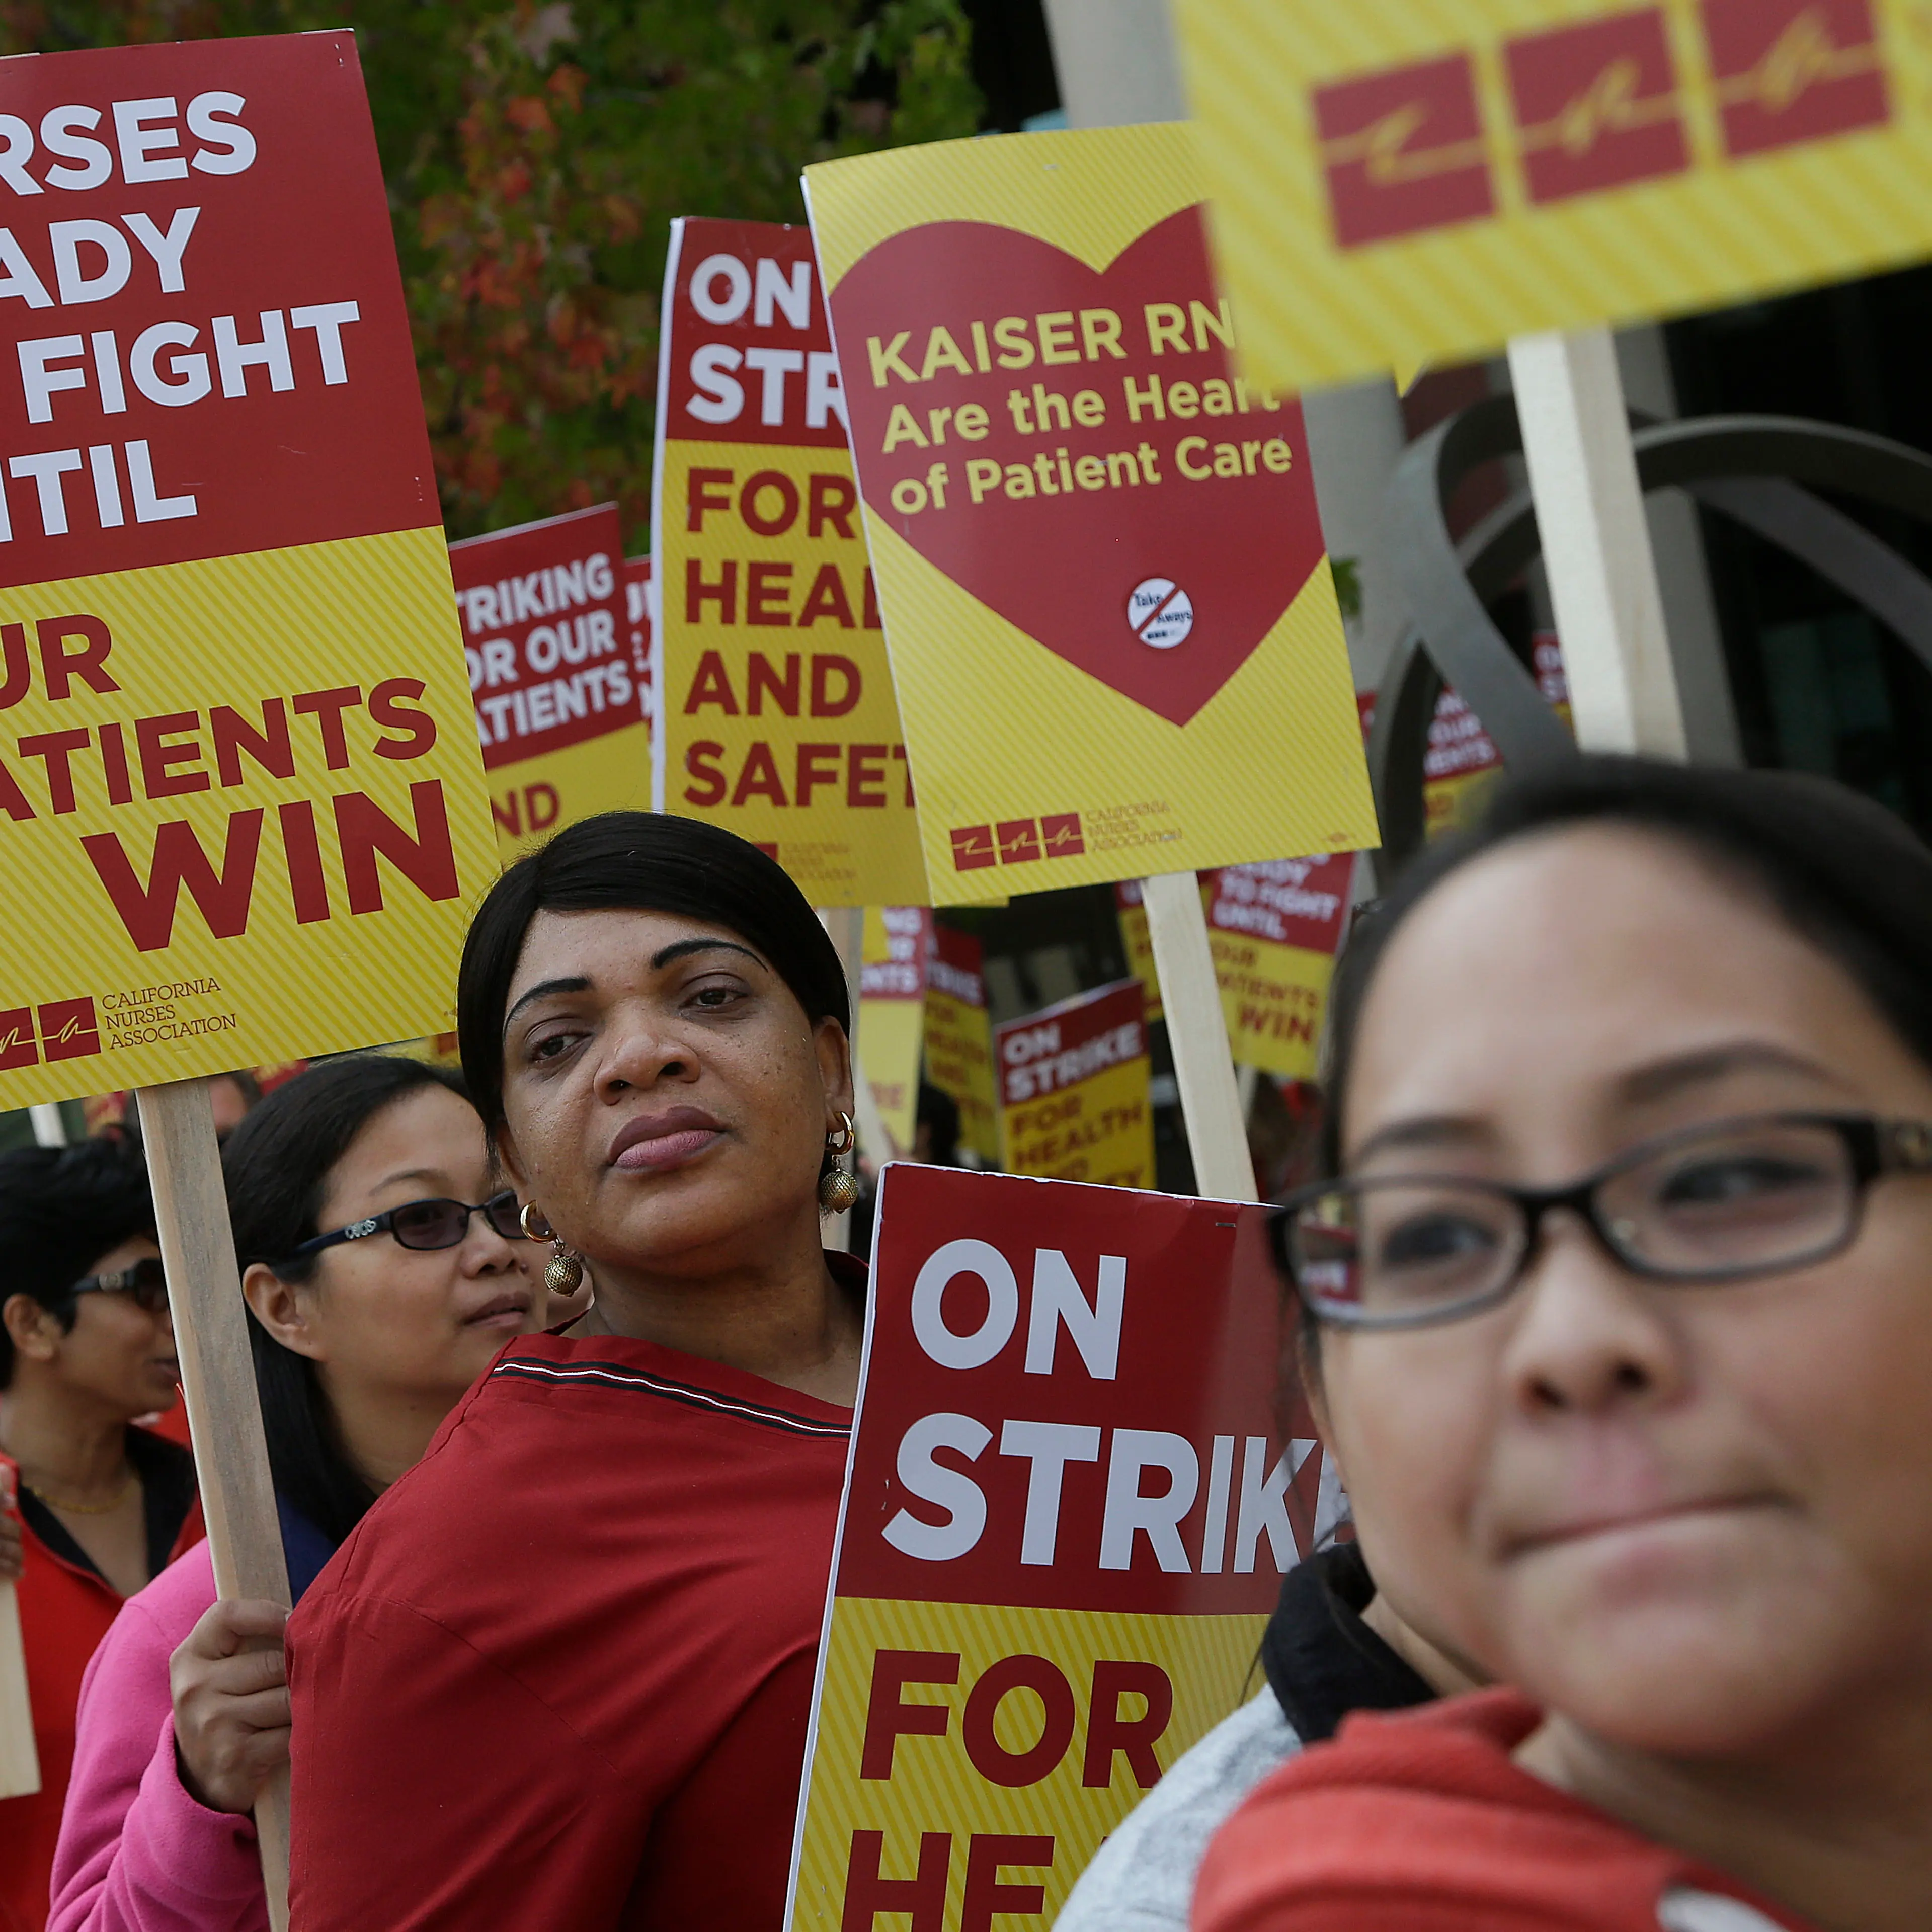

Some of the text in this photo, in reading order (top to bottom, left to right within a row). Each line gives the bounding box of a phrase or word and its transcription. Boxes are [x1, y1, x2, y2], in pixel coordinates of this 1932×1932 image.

[0, 91, 257, 196] RSES
[689, 253, 812, 330] ON
[16, 300, 360, 424] FIGHT
[866, 307, 1128, 389] KAISER
[881, 403, 991, 454] Are
[1006, 383, 1106, 434] the
[0, 439, 198, 542] TIL
[685, 466, 858, 540] FOR
[890, 435, 1293, 515] of Patient Care
[456, 553, 614, 635] RIKING
[525, 609, 617, 674] OUR
[682, 650, 862, 718] AND
[79, 779, 460, 953] WIN
[102, 977, 222, 1010] CALIFORNIA
[105, 1004, 176, 1030] NURSES
[109, 1013, 236, 1050] ASSOCIATION
[1003, 1022, 1062, 1066] ON
[1007, 1021, 1142, 1102] STRIKE
[911, 1238, 1128, 1382] ON
[859, 1649, 1173, 1789] FOR
[840, 1829, 1111, 1932] HE
